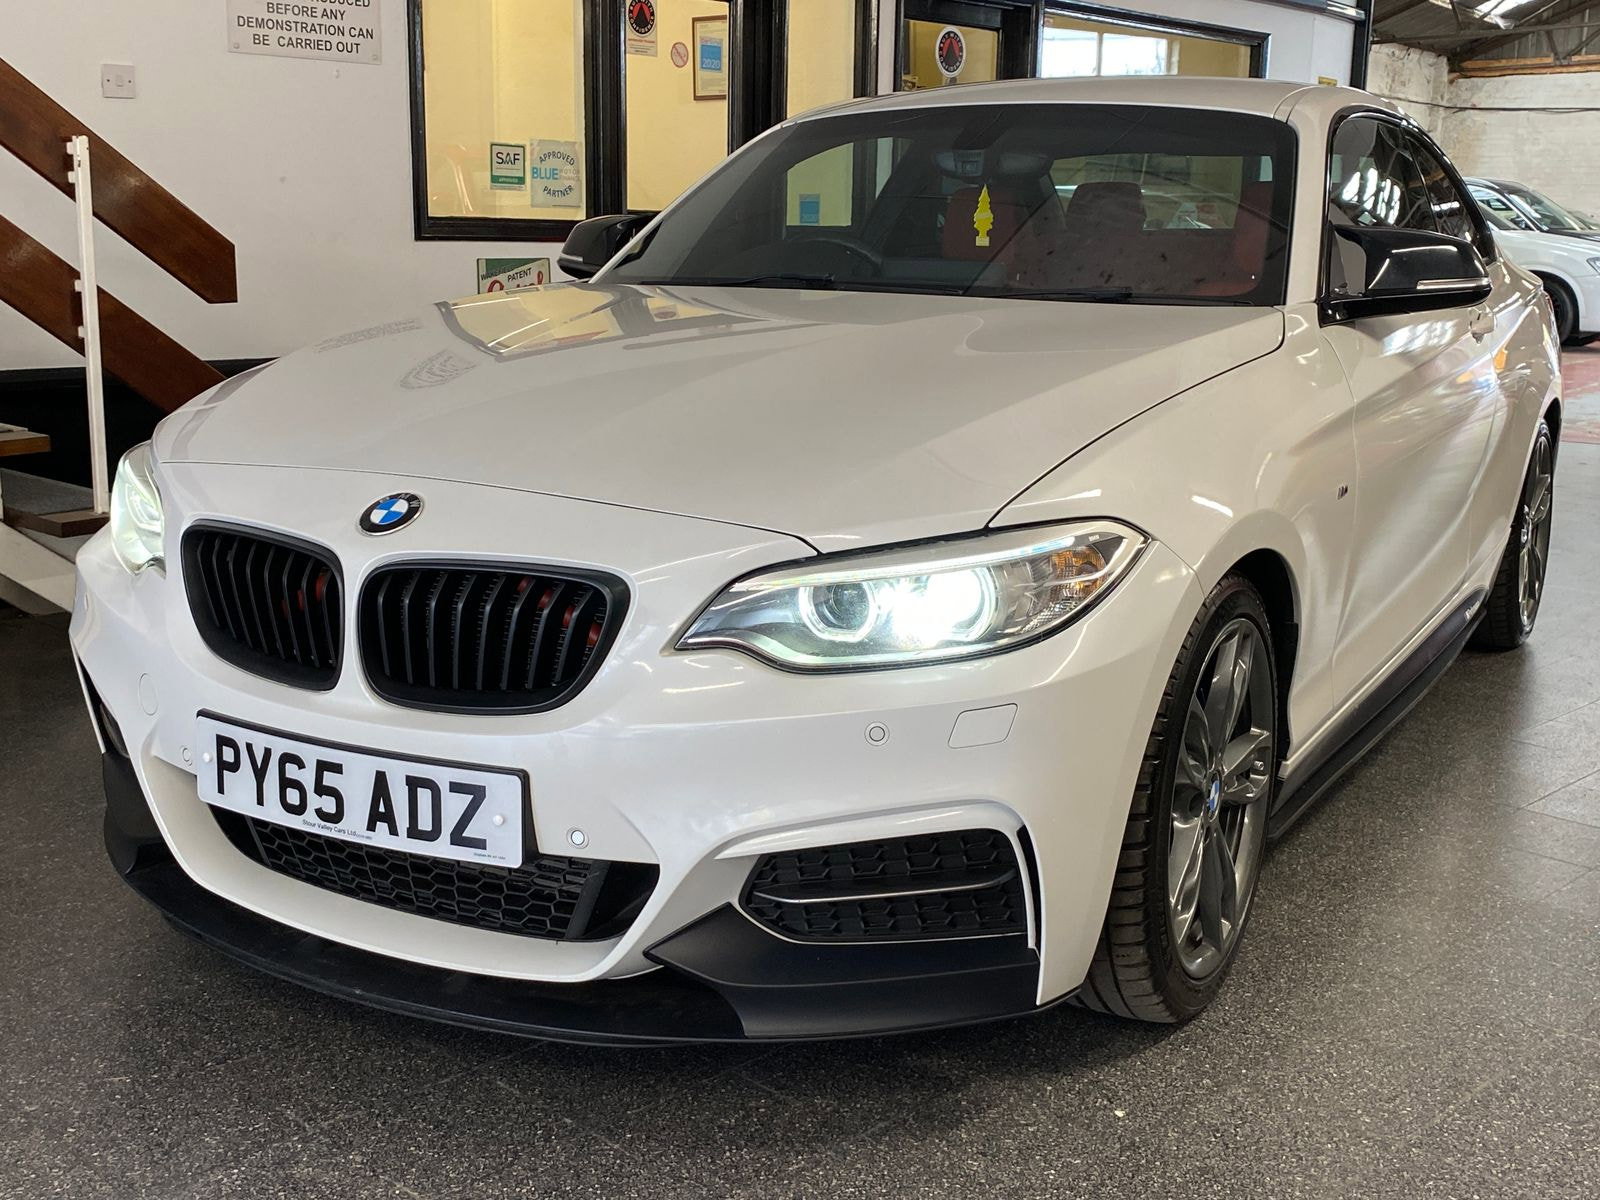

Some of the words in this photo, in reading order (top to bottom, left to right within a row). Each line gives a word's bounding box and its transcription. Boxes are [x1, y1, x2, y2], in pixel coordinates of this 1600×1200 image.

[267, 2, 318, 18] BEFORE
[320, 7, 346, 21] ANY
[237, 15, 345, 37] DEMONSTRATION
[348, 26, 375, 40] CAN
[252, 33, 270, 46] BE
[277, 35, 333, 52] CARRIED
[336, 41, 361, 54] OUT
[702, 57, 721, 69] 2020
[495, 151, 520, 165] SAF
[539, 150, 575, 166] APPROVED
[531, 167, 559, 180] BLUE
[542, 184, 574, 198] PARTNER
[507, 267, 532, 283] PATENT
[215, 733, 345, 825] PY65
[366, 769, 488, 851] ADZ
[317, 822, 333, 833] Valley
[333, 826, 346, 835] Cars
